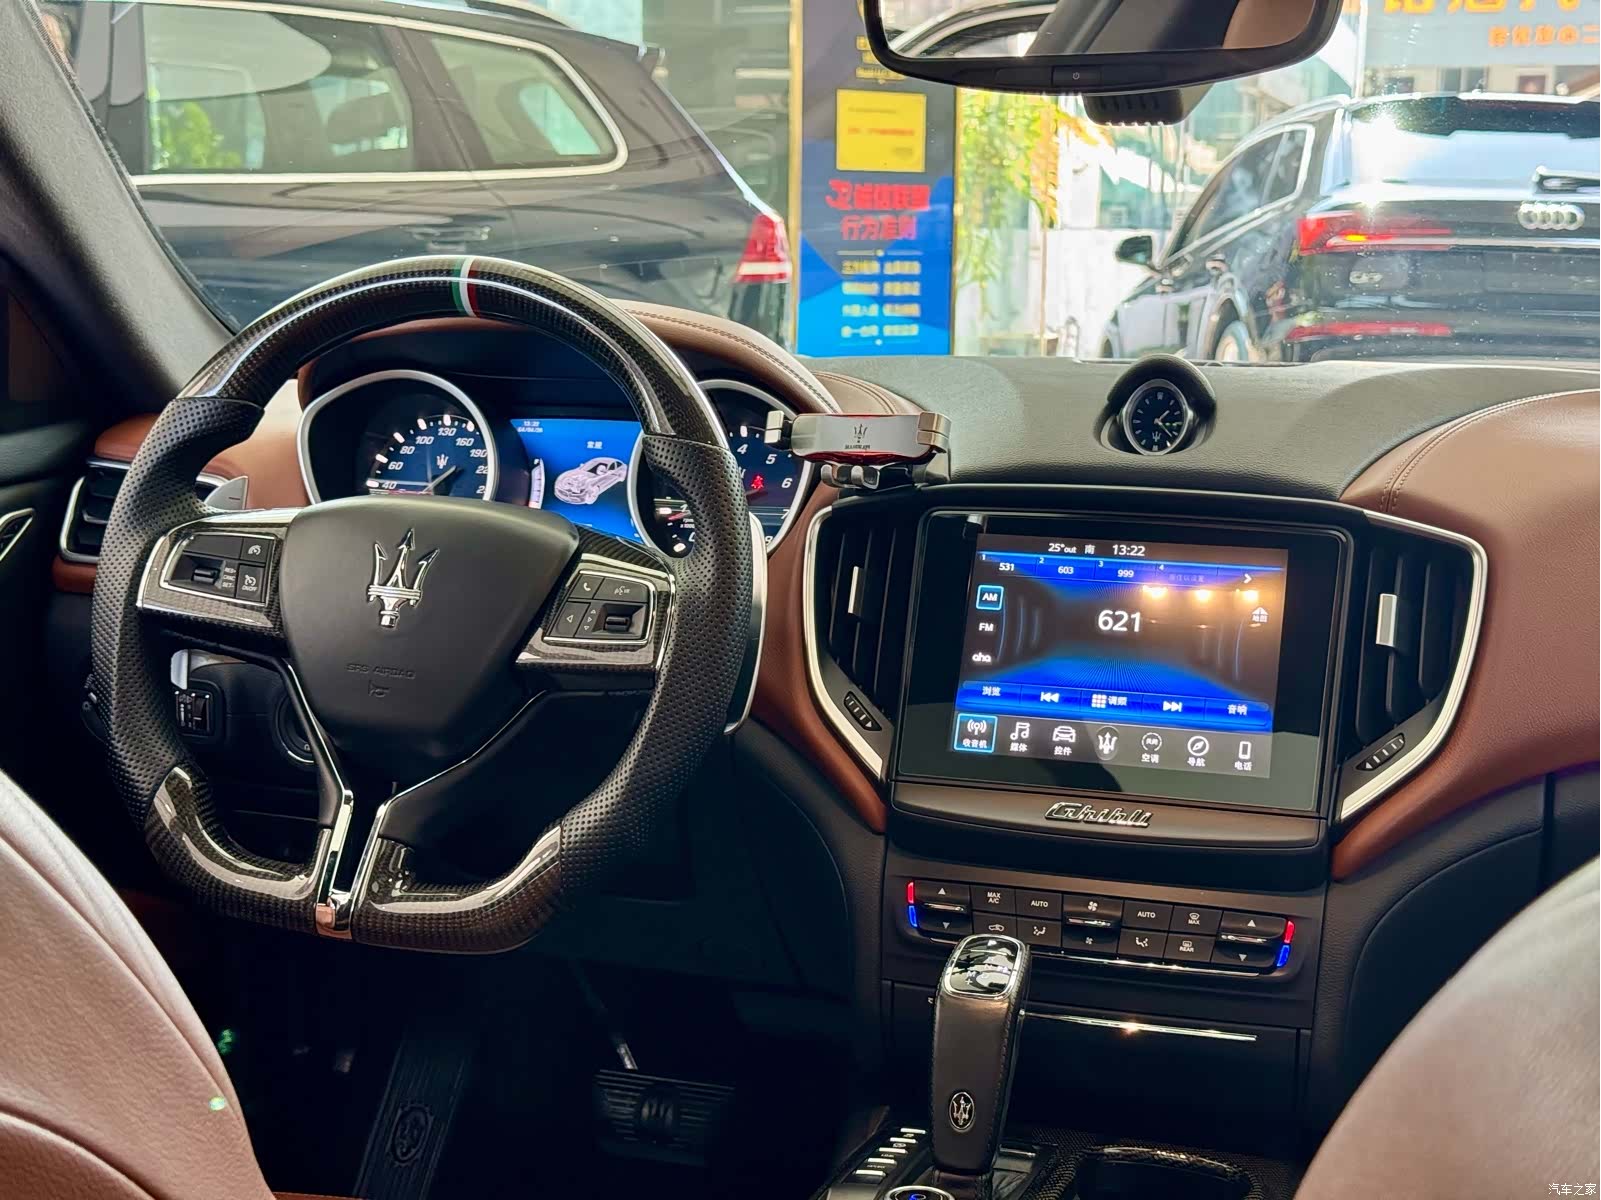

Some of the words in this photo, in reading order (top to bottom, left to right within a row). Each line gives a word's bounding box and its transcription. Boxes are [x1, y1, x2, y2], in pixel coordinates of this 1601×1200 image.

[437, 427, 457, 437] 130
[415, 435, 435, 445] 100
[455, 437, 475, 447] 160
[399, 446, 416, 455] 80
[469, 448, 488, 458] 190
[737, 443, 748, 455] 4
[765, 453, 777, 465] 5
[387, 462, 404, 471] 60
[382, 481, 397, 490] 40
[781, 477, 793, 489] 6
[680, 503, 688, 513] 1
[1112, 544, 1146, 557] 13:22
[998, 562, 1015, 571] 531
[1057, 565, 1075, 575] 603
[1117, 569, 1135, 578] 999
[981, 592, 998, 602] AM
[1097, 609, 1142, 633] 621
[978, 623, 994, 633] FM
[971, 652, 992, 664] aha
[981, 685, 1002, 697] 浏览
[1108, 694, 1128, 706] 调频
[1226, 704, 1248, 716] 音响
[962, 738, 988, 749] 收音机
[1009, 741, 1028, 753] 媒体
[1053, 745, 1073, 757] 控件
[1141, 752, 1160, 764] 空调
[1187, 757, 1206, 768] 导航
[1234, 761, 1253, 772] 电话
[987, 891, 1001, 899] MAX
[1030, 899, 1049, 908] AUTO
[1137, 911, 1156, 919] AUTO
[1179, 945, 1195, 953] REAR
